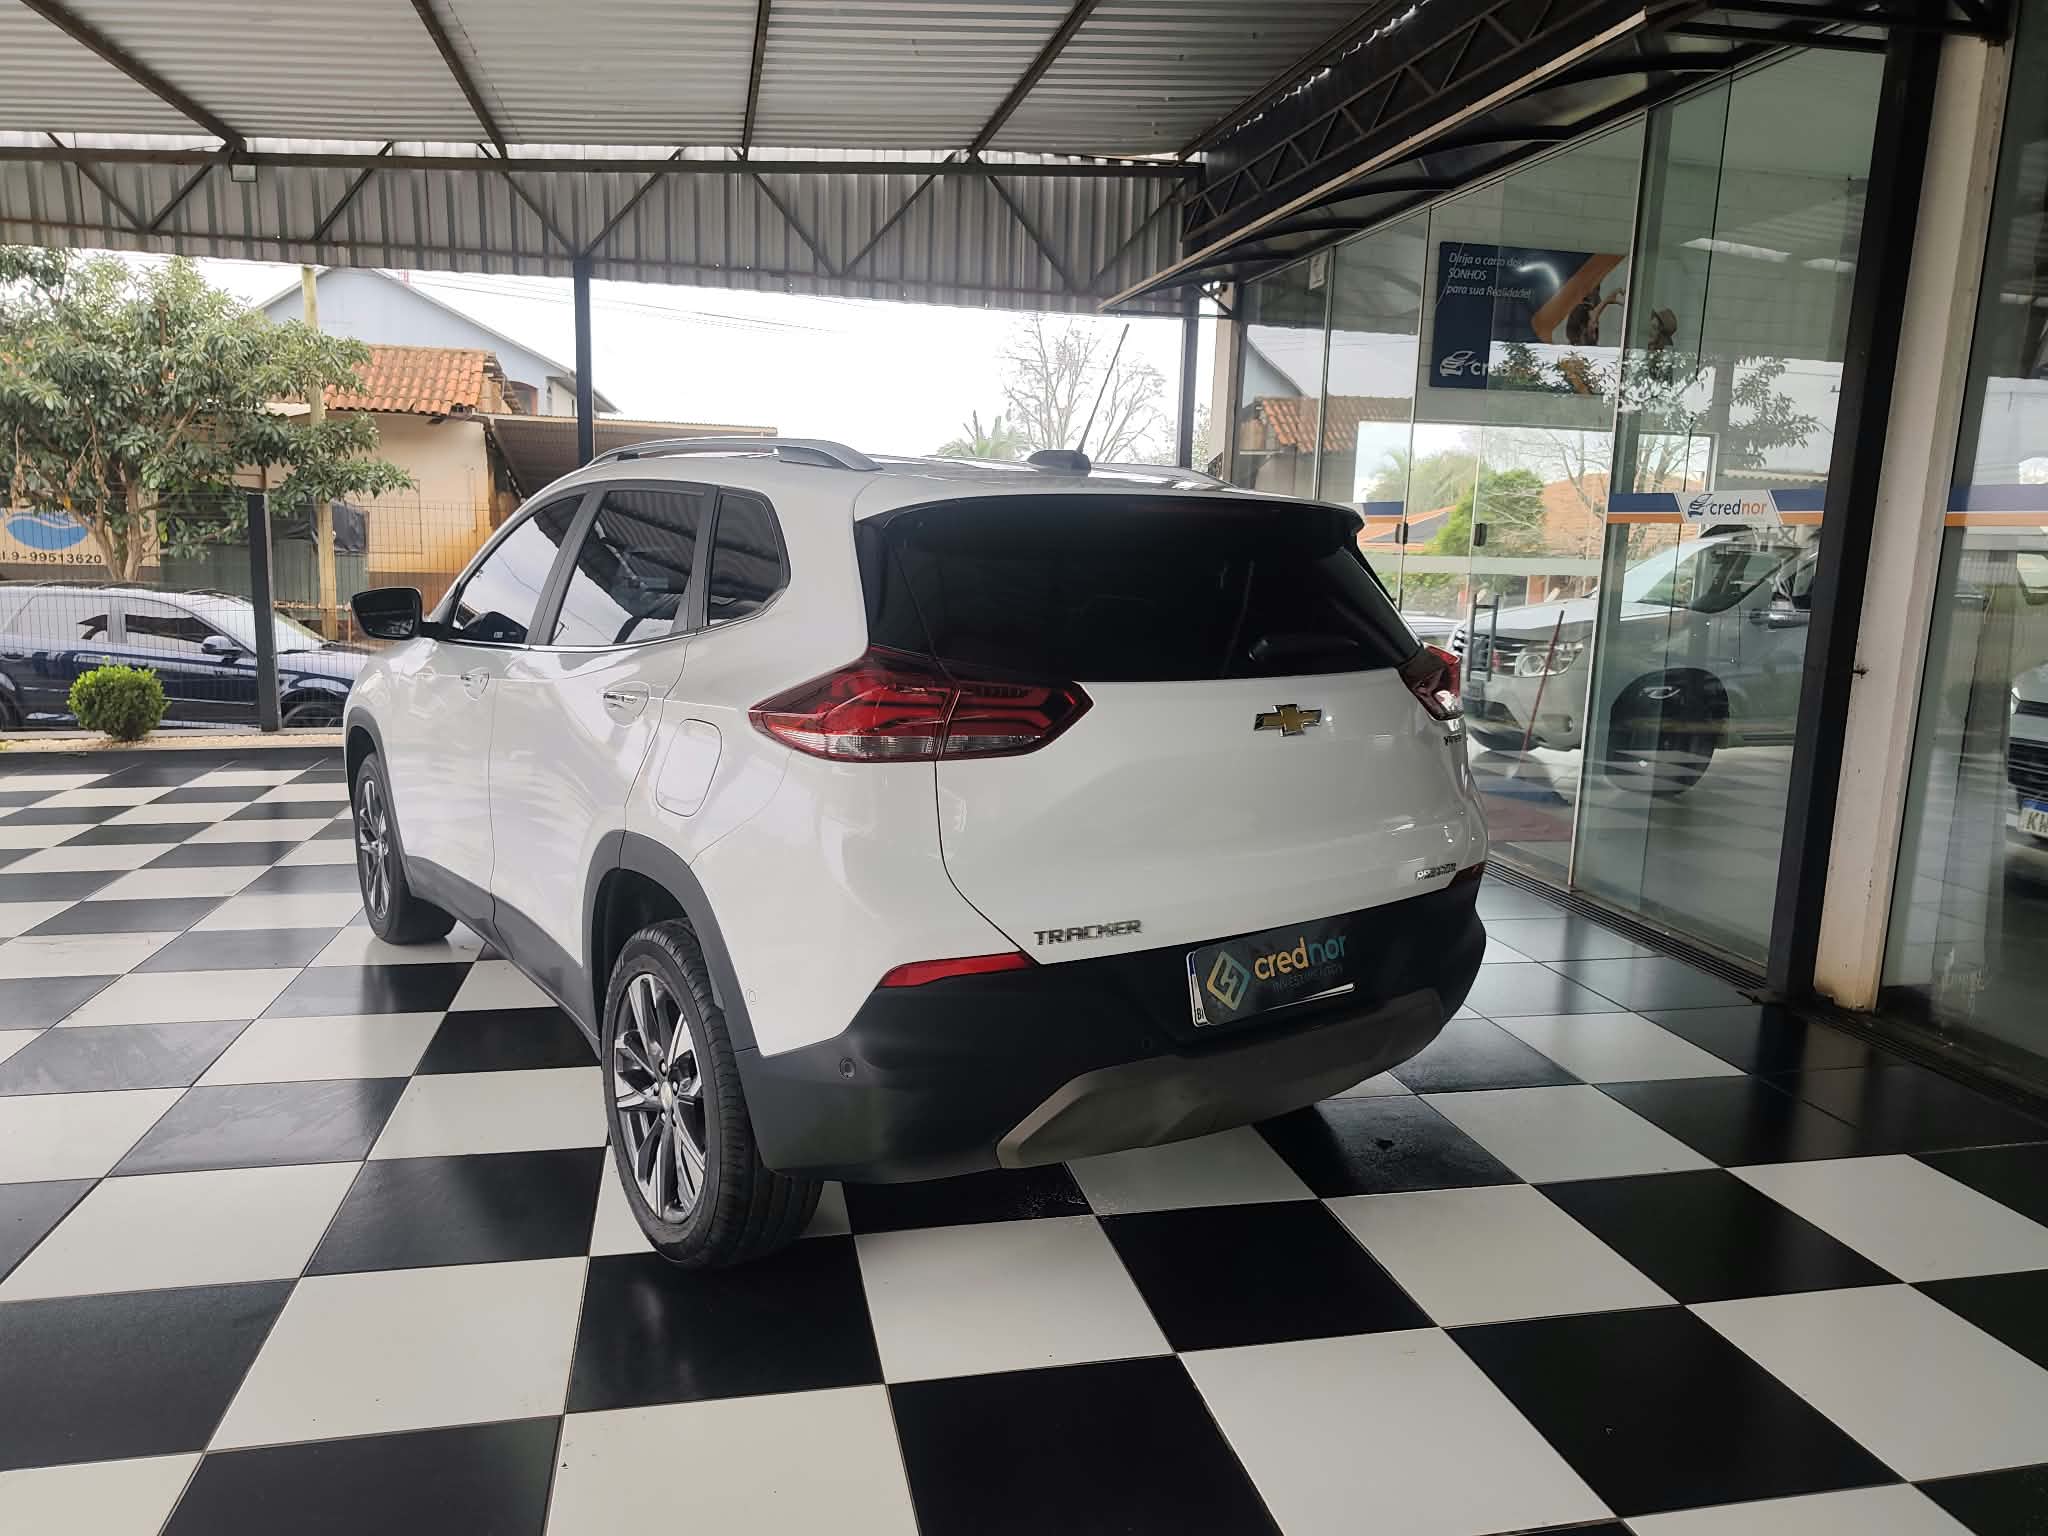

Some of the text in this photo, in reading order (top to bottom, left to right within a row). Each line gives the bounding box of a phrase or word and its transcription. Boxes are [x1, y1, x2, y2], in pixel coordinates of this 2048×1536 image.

[1448, 268, 1488, 281] SONHOS
[1446, 286, 1469, 297] para
[1469, 287, 1486, 296] sua
[1709, 495, 1767, 516] crednor
[1033, 920, 1142, 946] TRACKER
[1253, 934, 1347, 980] crednor
